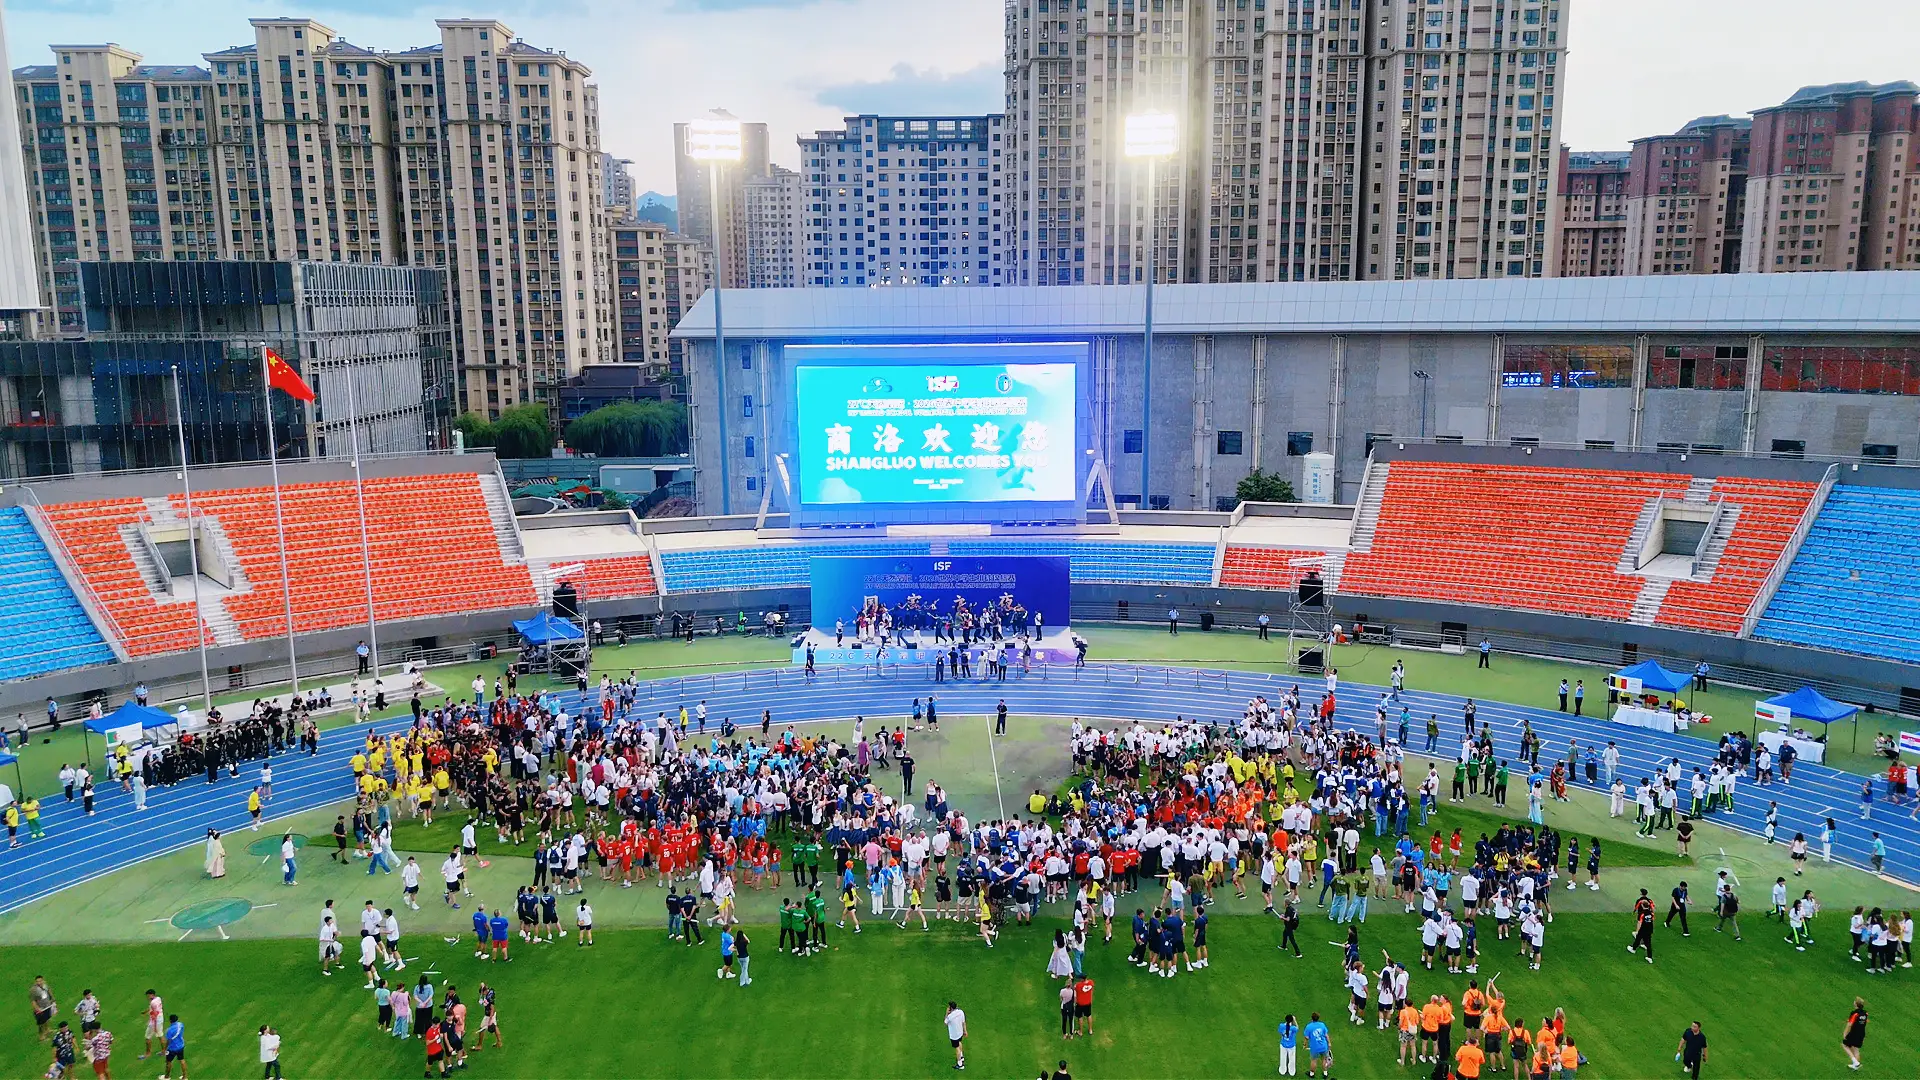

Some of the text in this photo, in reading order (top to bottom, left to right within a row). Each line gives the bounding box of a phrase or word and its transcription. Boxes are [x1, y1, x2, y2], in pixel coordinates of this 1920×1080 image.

[825, 421, 1049, 454] 商洛欢迎您
[826, 453, 1048, 471] SHANGLUO WELCOMES YOU
[933, 561, 952, 571] ISF
